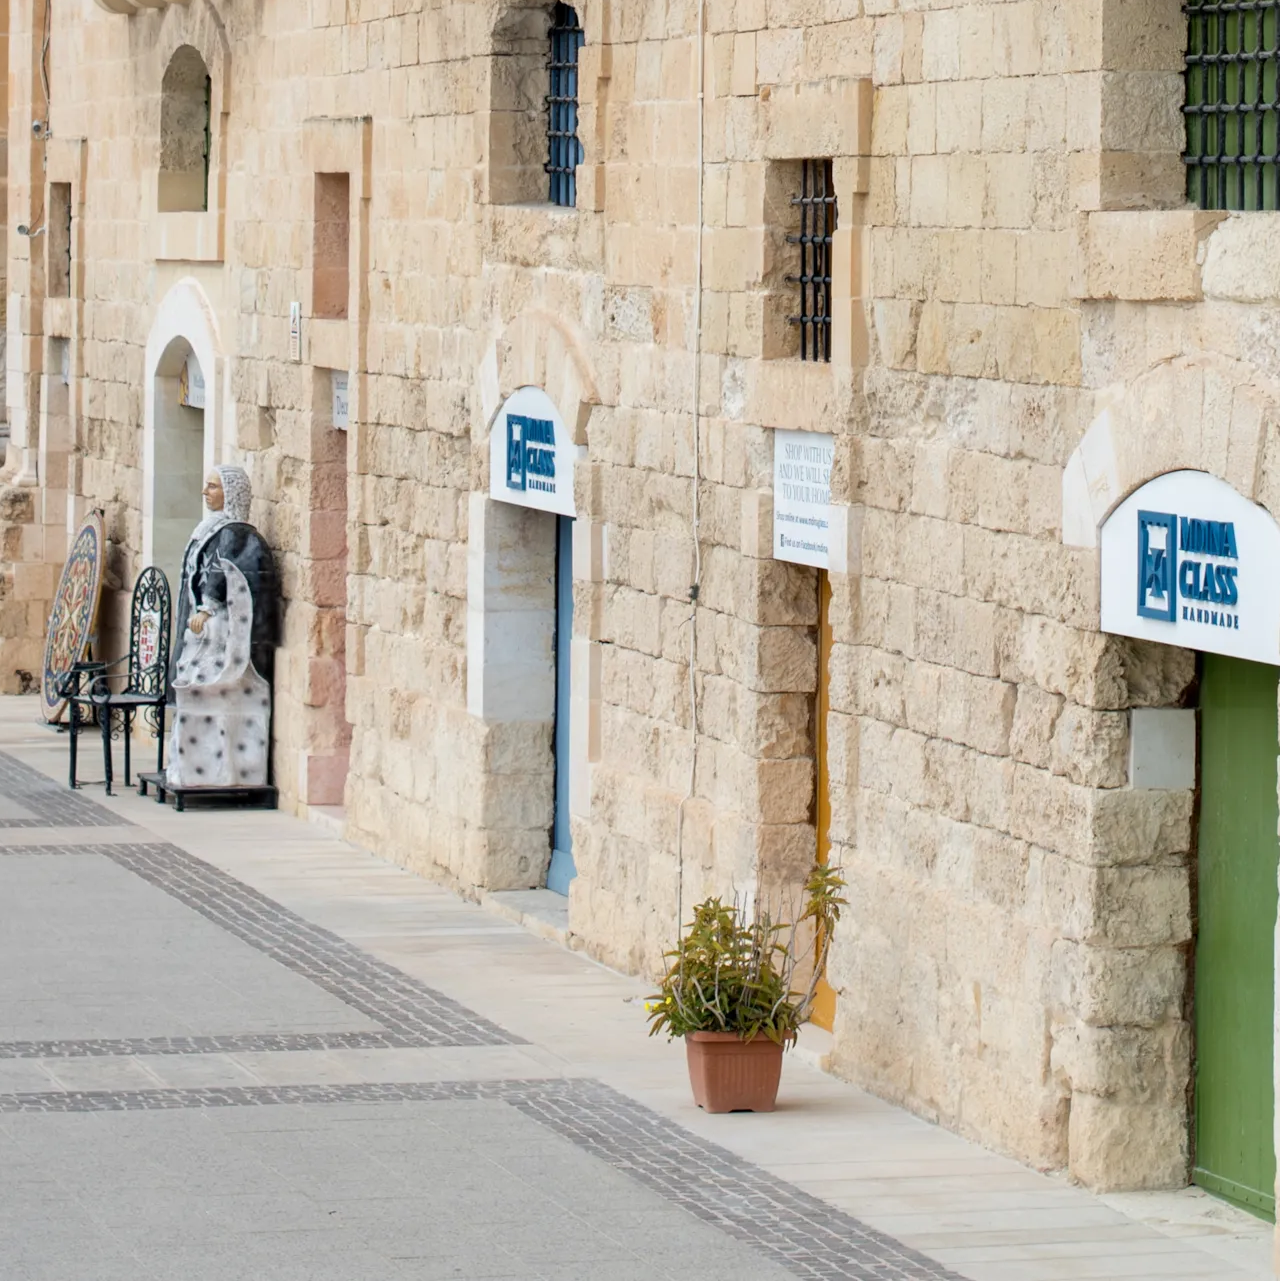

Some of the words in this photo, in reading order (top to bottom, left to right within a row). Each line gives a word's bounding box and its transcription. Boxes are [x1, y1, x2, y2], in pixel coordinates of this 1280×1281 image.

[526, 417, 555, 446] MDINA
[785, 443, 803, 461] SHOP
[803, 446, 821, 464] WITH
[822, 448, 832, 465] US
[780, 463, 793, 479] AND
[794, 465, 805, 481] WE
[805, 466, 822, 484] WILL
[528, 479, 556, 494] HANDMADE
[782, 483, 791, 499] TO
[792, 484, 811, 502] YOUR
[1179, 516, 1239, 560] MDINA
[1182, 606, 1239, 630] HANDMADE
